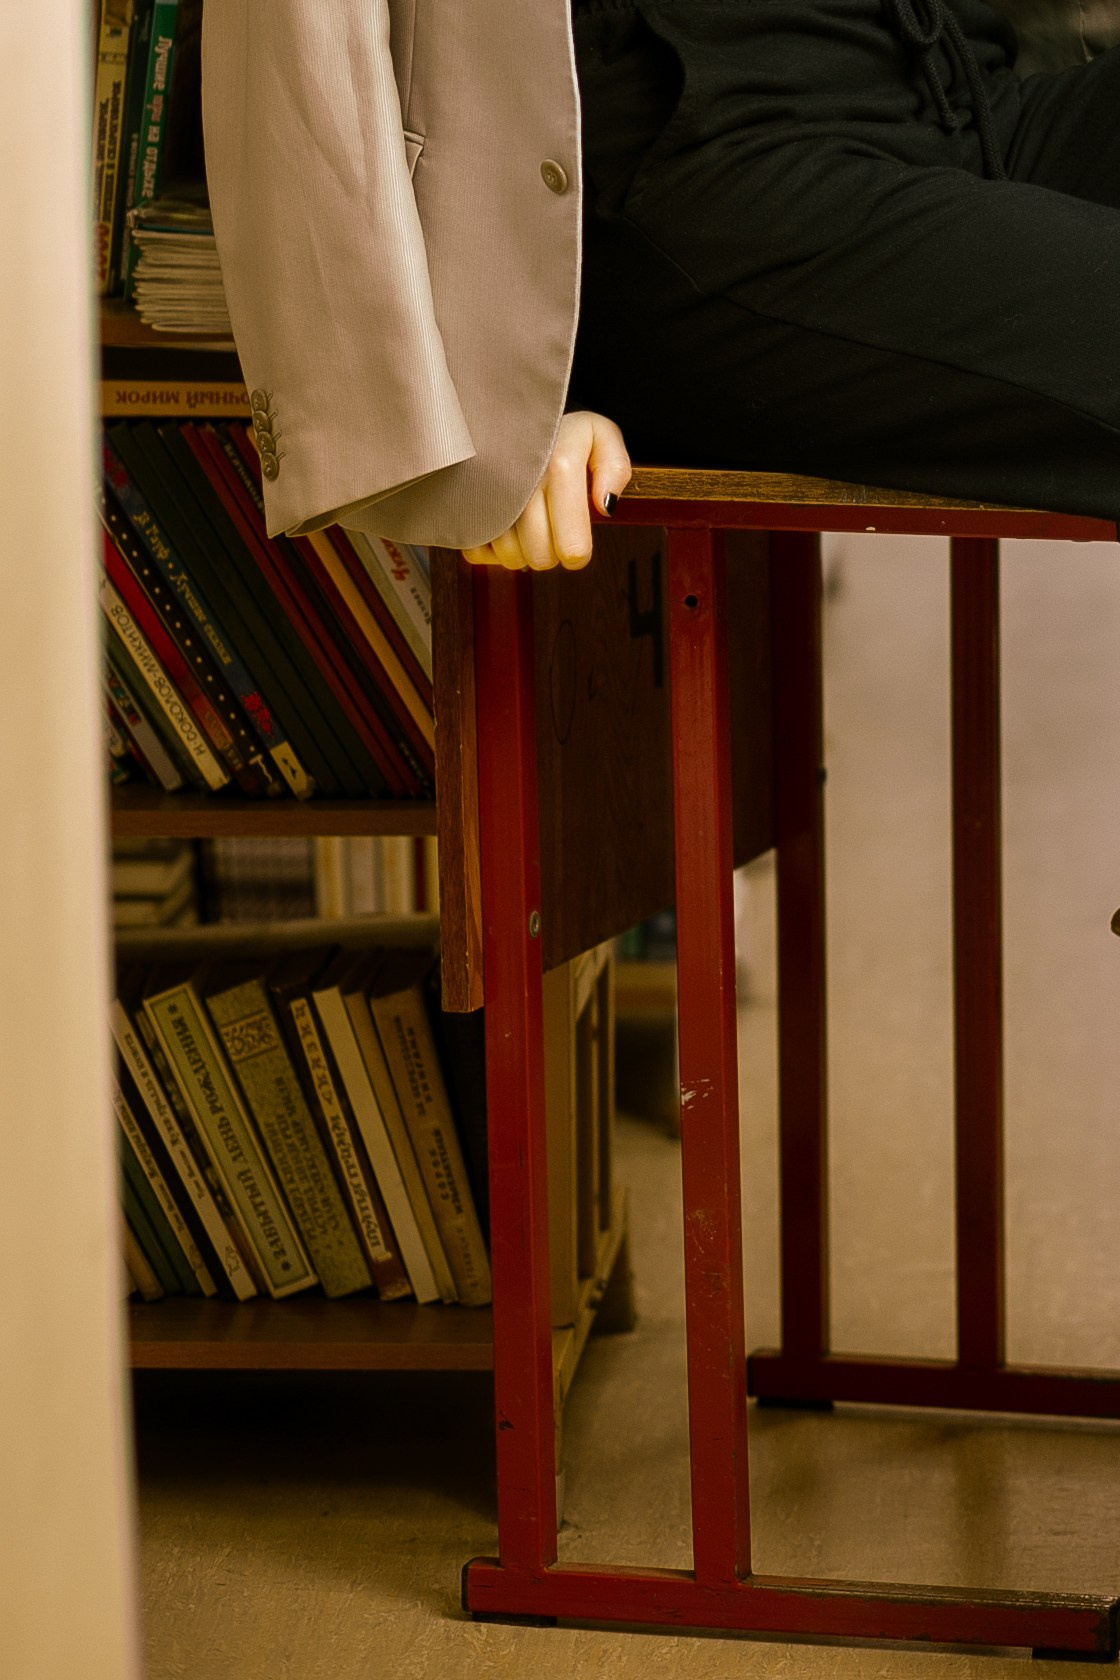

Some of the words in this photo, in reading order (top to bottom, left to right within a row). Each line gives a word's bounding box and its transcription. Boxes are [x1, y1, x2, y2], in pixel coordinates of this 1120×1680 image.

[152, 36, 173, 90] Лучшие
[147, 126, 160, 142] на
[141, 147, 158, 198] отдыхе
[115, 390, 179, 405] МИРОК
[172, 1016, 225, 1116] РОЖДЕНИЯ
[217, 1116, 248, 1163] ДЕНЬ
[237, 1168, 286, 1259] ЗАБЫТЫЙ
